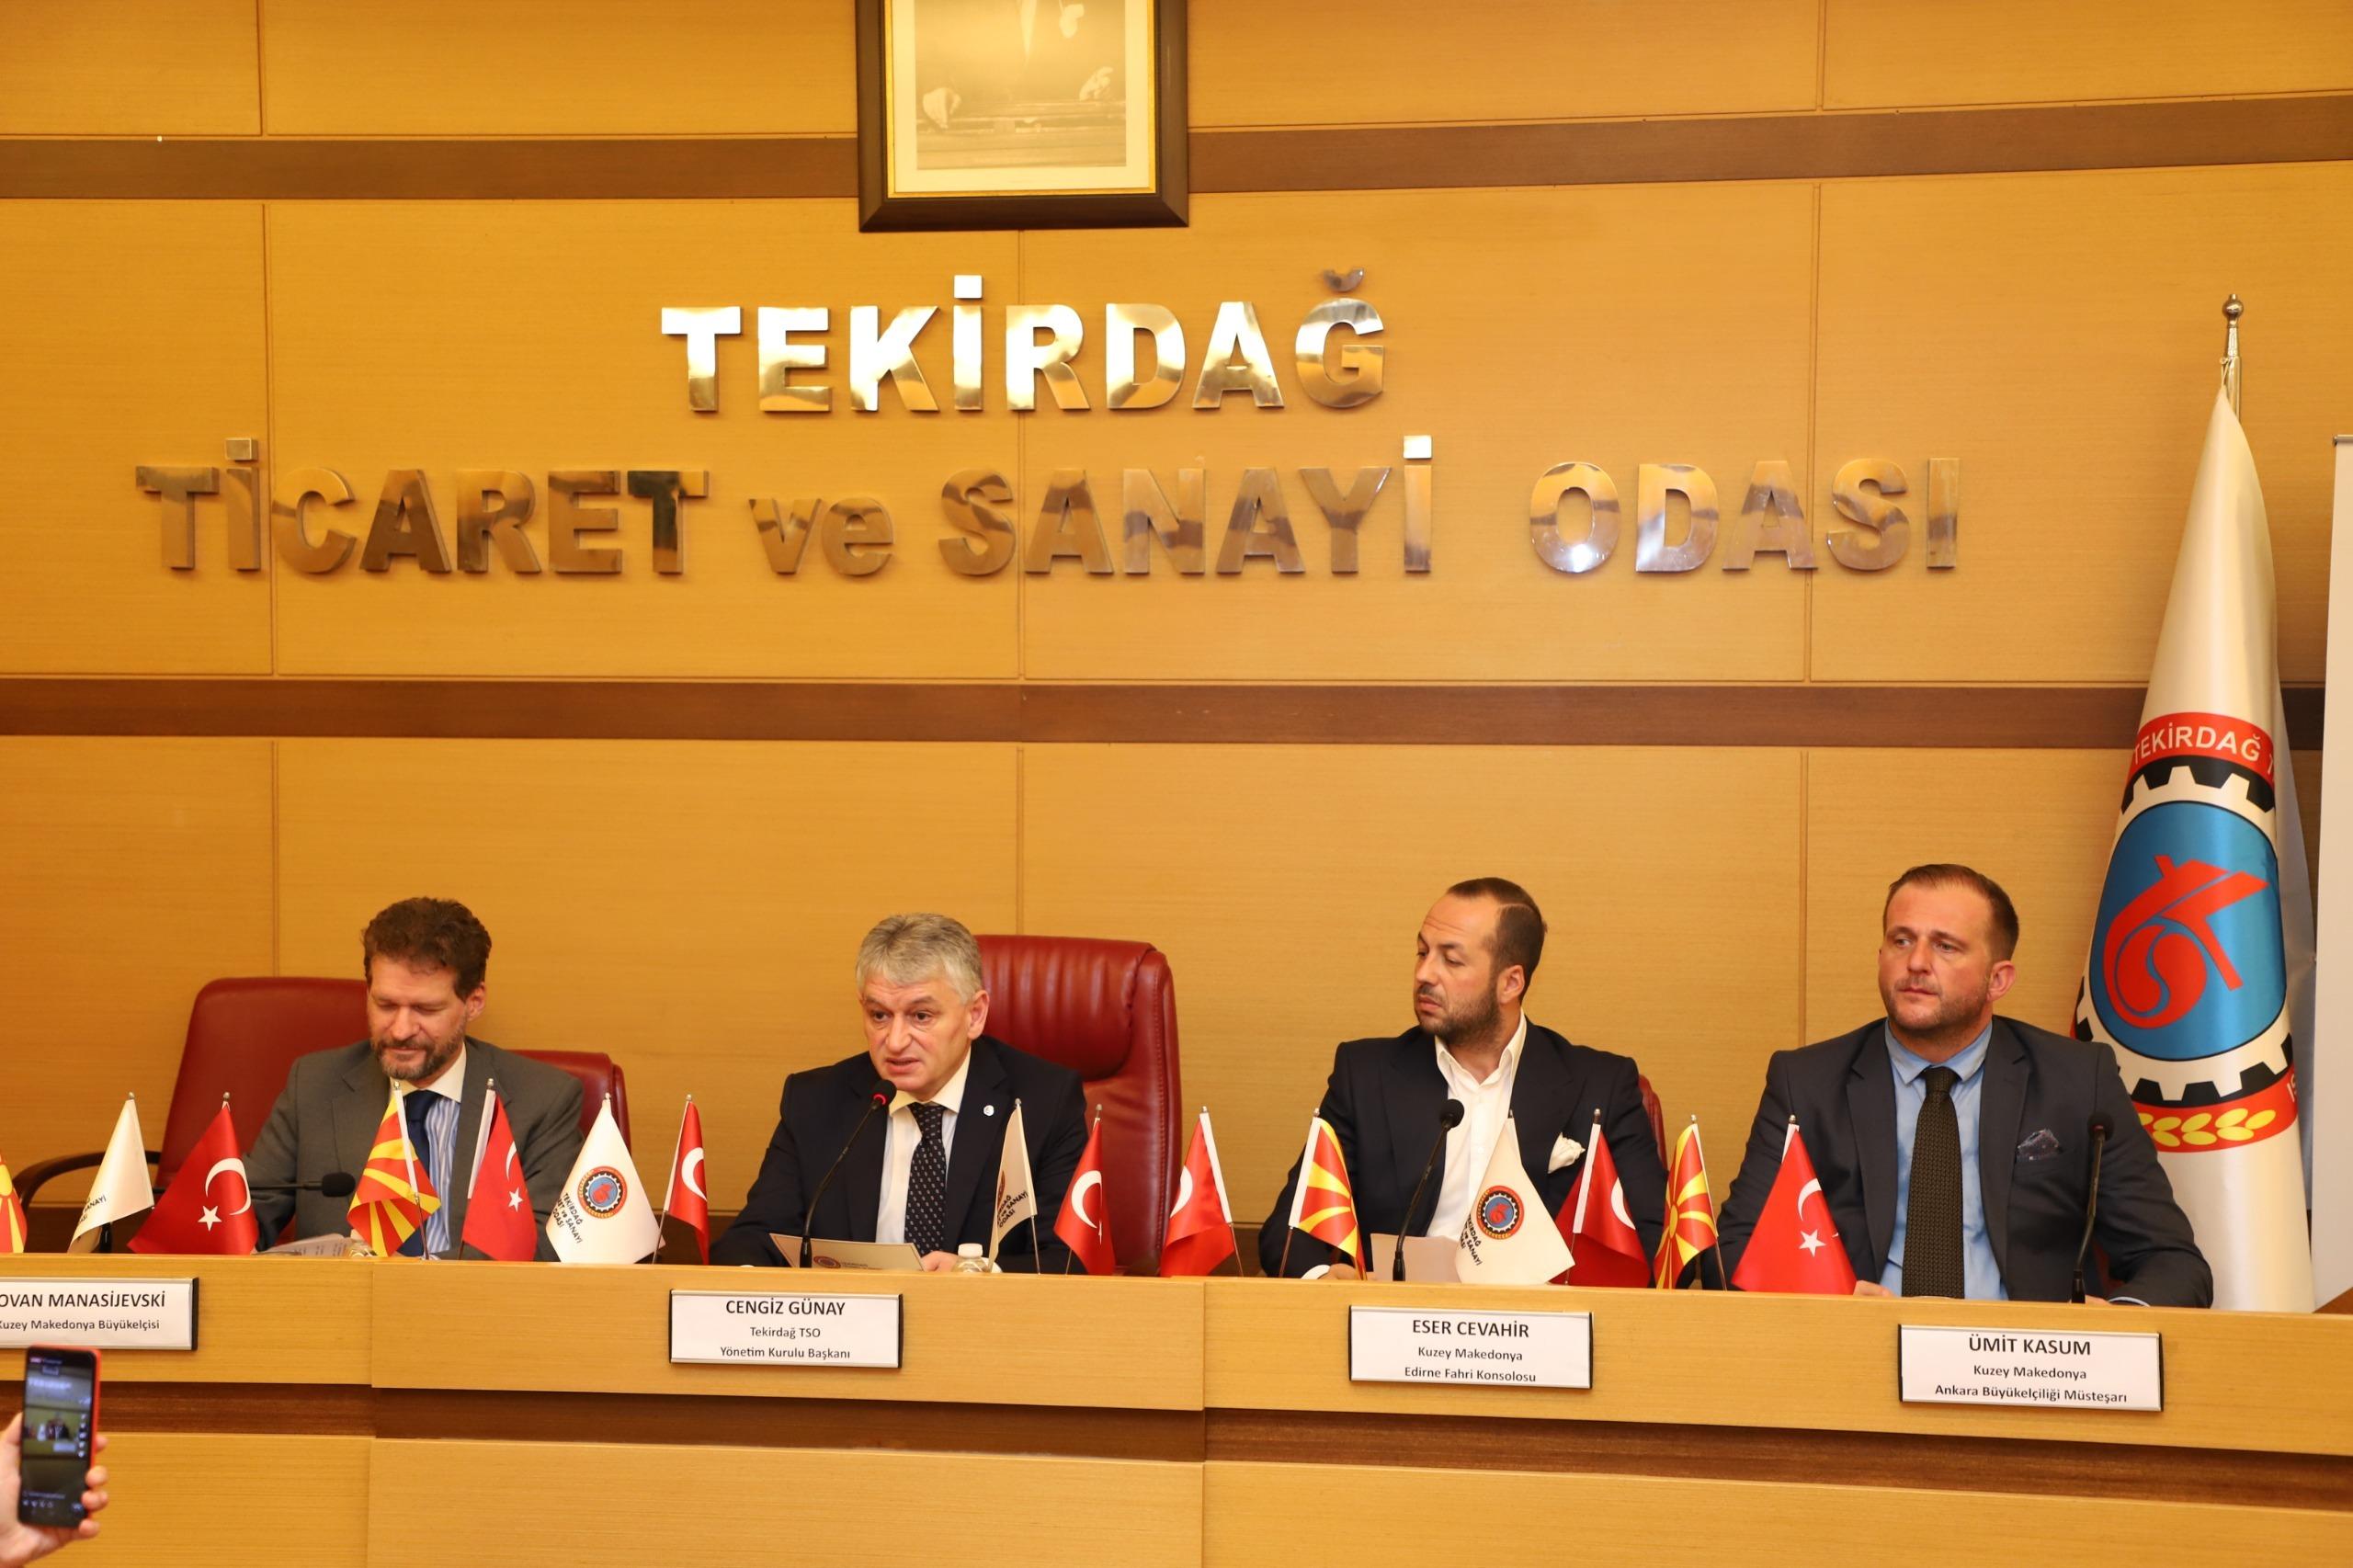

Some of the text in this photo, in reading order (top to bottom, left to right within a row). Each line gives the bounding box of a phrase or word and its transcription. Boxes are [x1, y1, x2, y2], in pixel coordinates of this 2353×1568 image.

[661, 269, 1385, 412] TEKİRDAĞ
[135, 435, 1959, 576] TİCARET ve SANAYİ ODASI
[2134, 722, 2262, 766] TEKİRDAĞ
[48, 1290, 165, 1308] MANASİJEVSKİ
[725, 1297, 846, 1316] CENGİZ GÜNAY
[30, 1319, 96, 1332] Makedonya
[98, 1319, 160, 1332] Büyükelçisi
[750, 1326, 821, 1340] Tekirdağ TSO
[1413, 1319, 1529, 1338] ESER CEVAHİR
[720, 1346, 850, 1361] Yönetim Kurulu Başkanı
[1418, 1346, 1523, 1361] Kuzey Makedonya
[1969, 1334, 2091, 1356] ÜMİT KASUM
[1404, 1367, 1536, 1382] Edirne Fahri Konsolosu
[1973, 1365, 2086, 1381] Kuzey Makedonya
[1935, 1384, 2127, 1403] Ankara Büyükelçiliği Müsteşarı
